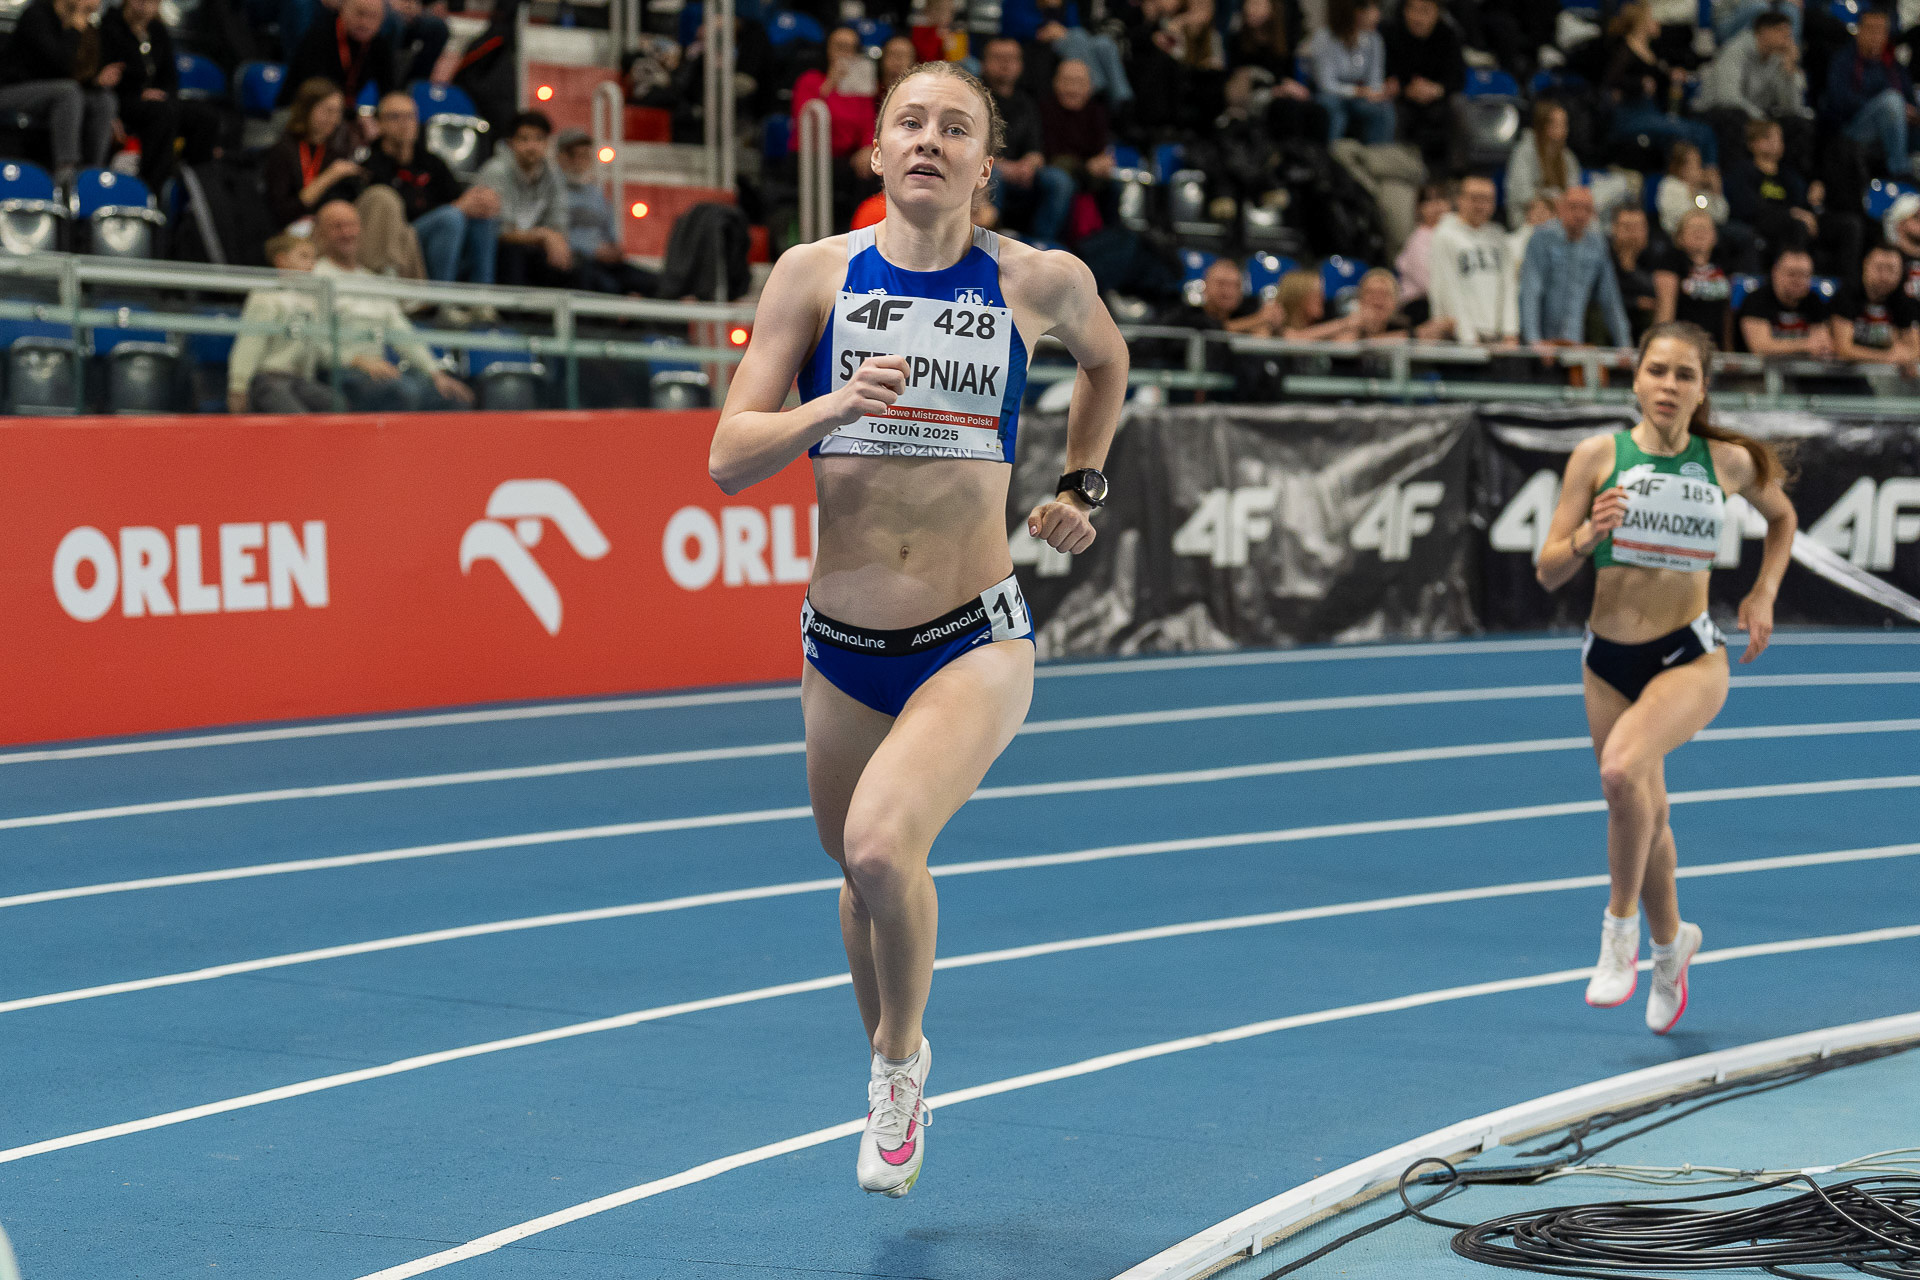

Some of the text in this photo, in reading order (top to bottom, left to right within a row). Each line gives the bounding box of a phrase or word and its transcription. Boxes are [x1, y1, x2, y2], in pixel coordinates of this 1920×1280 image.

[846, 299, 996, 340] 4F 428
[839, 349, 1000, 397] STPNIAK
[868, 422, 959, 441] TORUŃ 2025
[882, 408, 993, 427] alowe Mistrzostwa Polski
[849, 441, 885, 456] AZS
[1682, 484, 1715, 504] 185
[1172, 486, 1278, 567] 4F
[1351, 481, 1445, 561] 4F
[1489, 469, 1563, 567] 4
[662, 505, 819, 591] ORL
[52, 520, 329, 622] ORLEN
[911, 606, 986, 647] AdRunaLin
